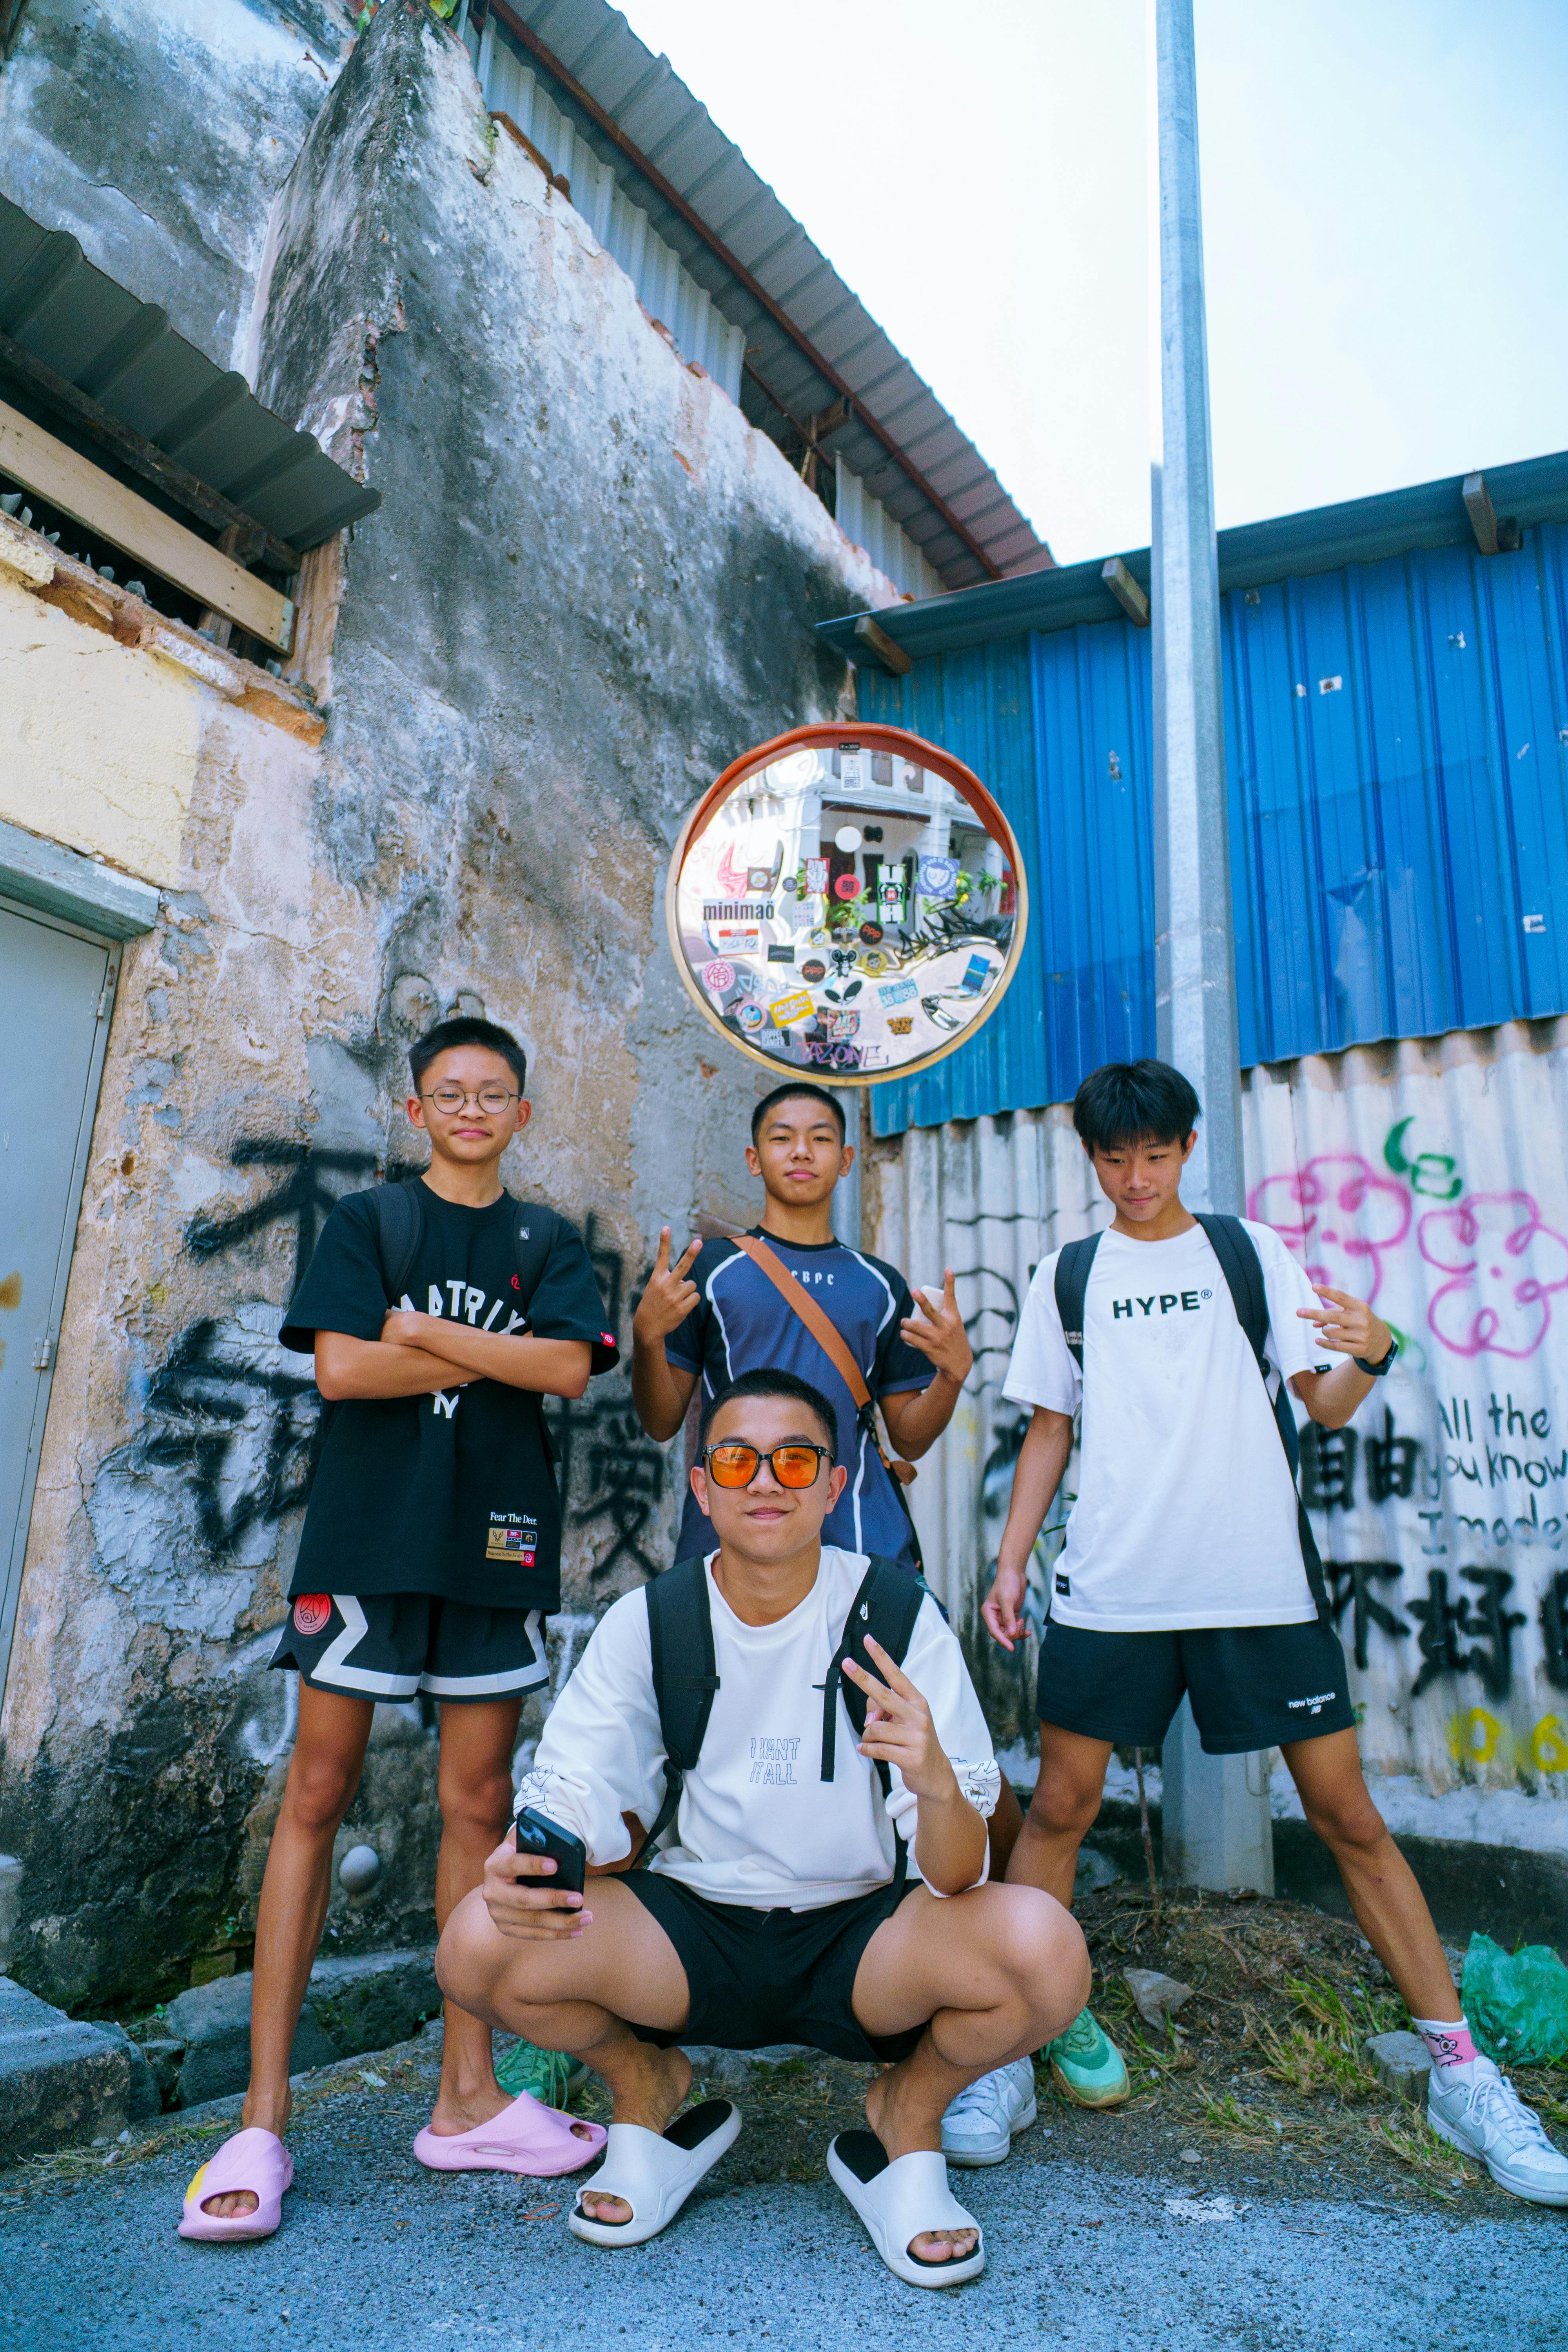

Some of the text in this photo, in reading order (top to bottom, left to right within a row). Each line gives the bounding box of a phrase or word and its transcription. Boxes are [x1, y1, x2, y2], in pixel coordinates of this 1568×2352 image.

[703, 901, 774, 920] minimaö
[1488, 1392, 1551, 1439] the
[1298, 1403, 1422, 1512] 自由
[1421, 1443, 1568, 1501] you know
[490, 1512, 537, 1525] Fear The Deer.
[1418, 1510, 1448, 1556] I
[1323, 1560, 1568, 1704] 不好
[1288, 1692, 1336, 1709] new balance
[751, 1738, 800, 1760] I WANT
[750, 1762, 797, 1785] IT ALL
